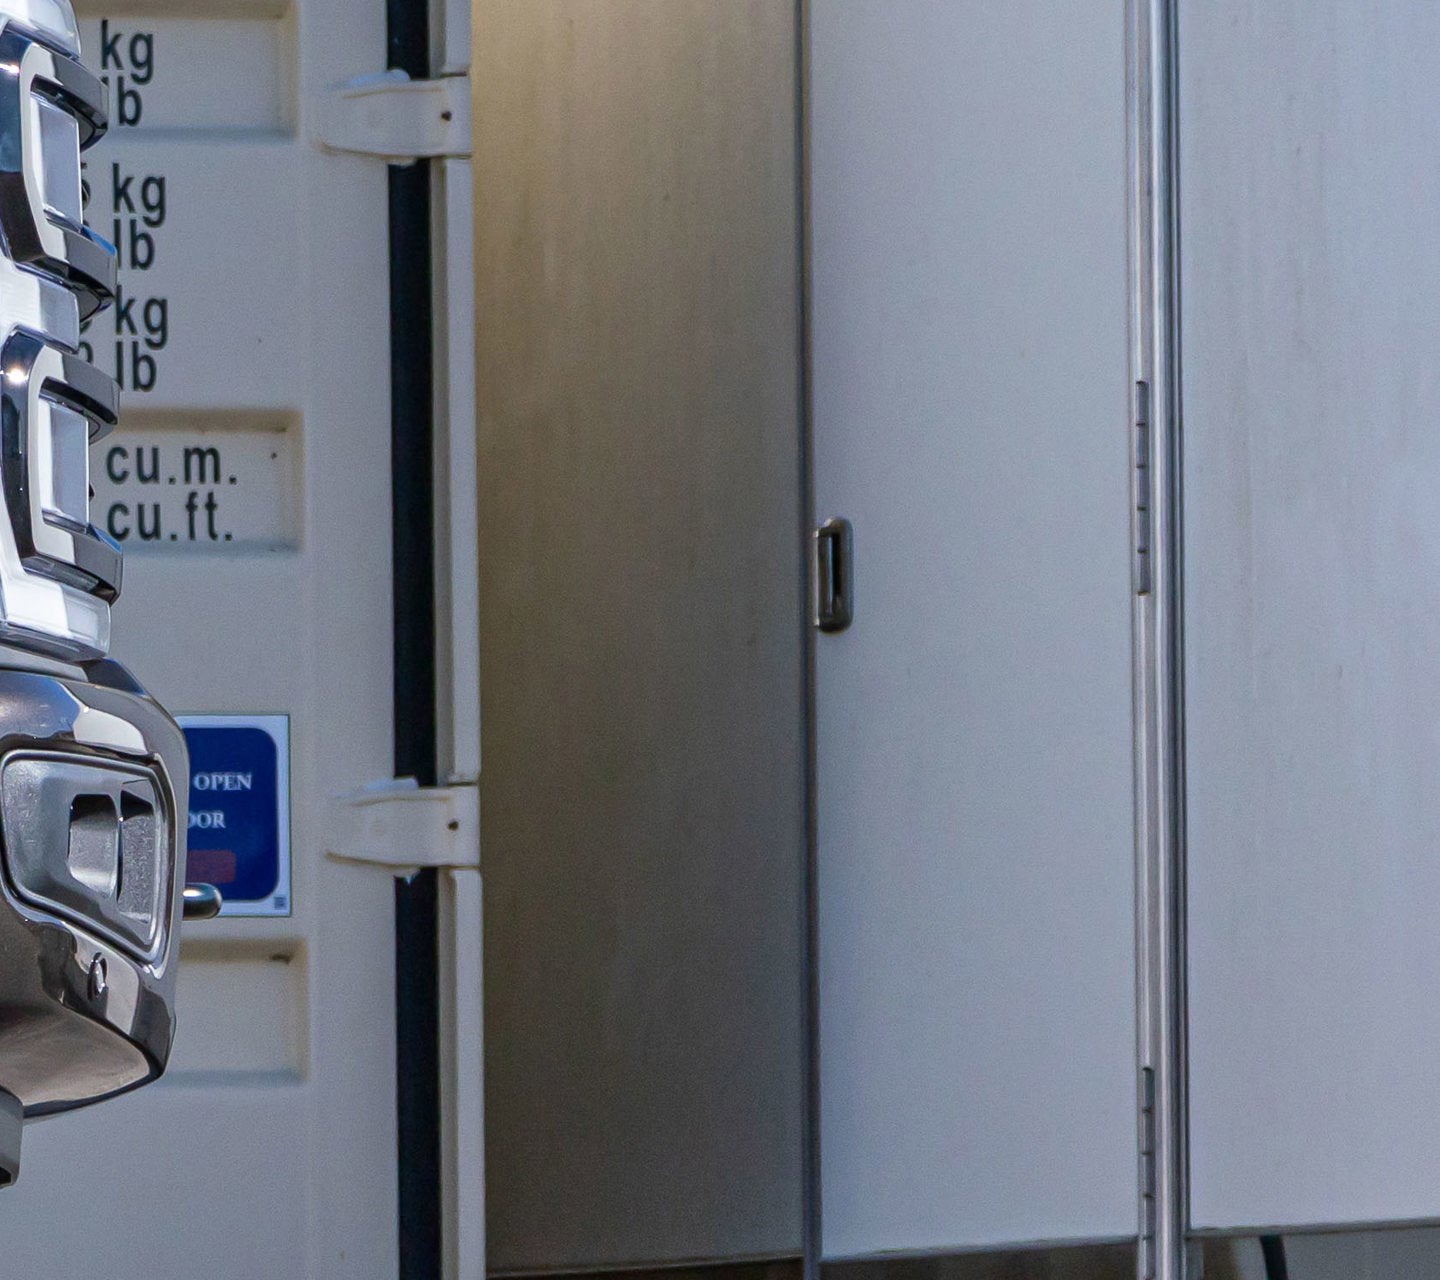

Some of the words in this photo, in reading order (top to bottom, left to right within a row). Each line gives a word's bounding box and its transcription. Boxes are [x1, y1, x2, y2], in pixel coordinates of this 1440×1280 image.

[100, 18, 154, 85] kg
[112, 162, 167, 228] kg
[114, 218, 156, 270] lb
[115, 284, 169, 350] kg
[115, 340, 158, 393] lb
[106, 445, 238, 485] cu.m.
[106, 491, 234, 541] cu.ft.
[192, 772, 254, 792] OPEN
